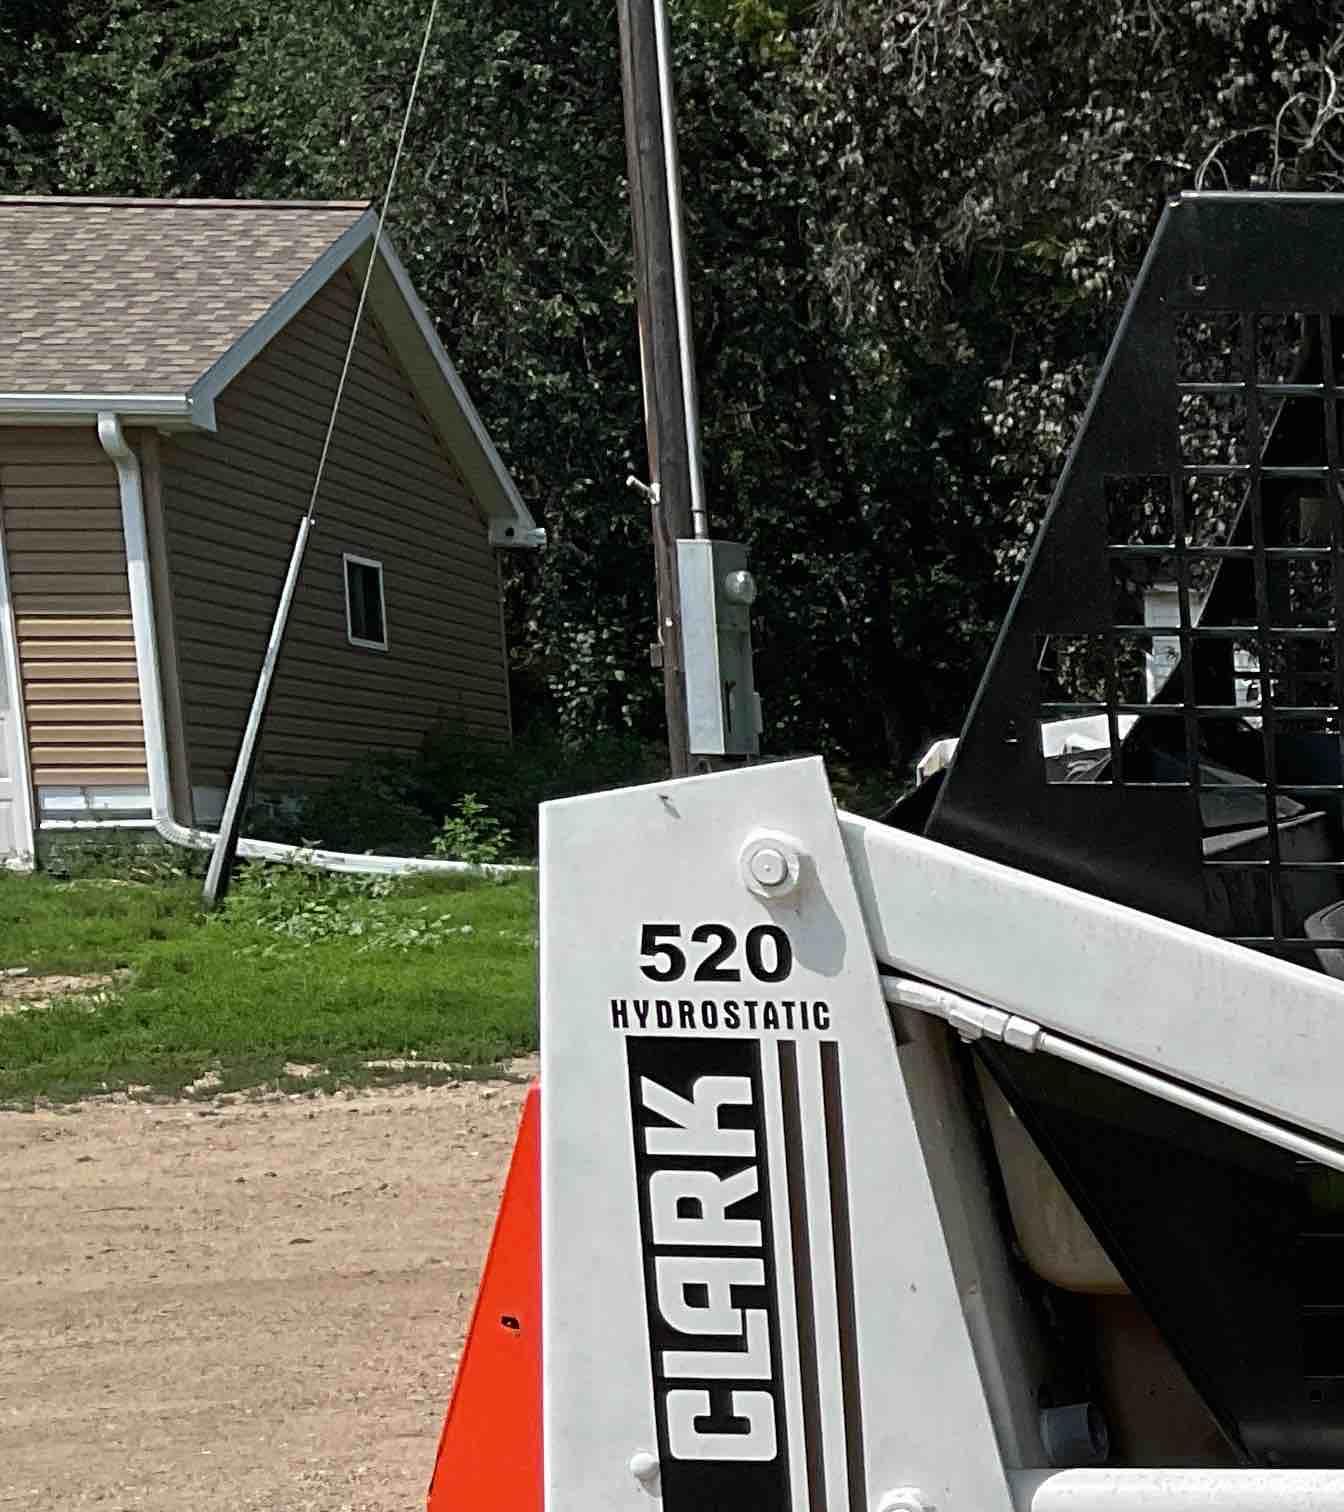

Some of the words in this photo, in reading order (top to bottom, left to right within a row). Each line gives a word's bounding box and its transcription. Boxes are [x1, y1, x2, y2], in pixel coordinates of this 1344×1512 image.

[640, 924, 794, 984] 520
[611, 999, 831, 1030] HYDROSTATIC
[642, 1075, 778, 1461] CLARK
